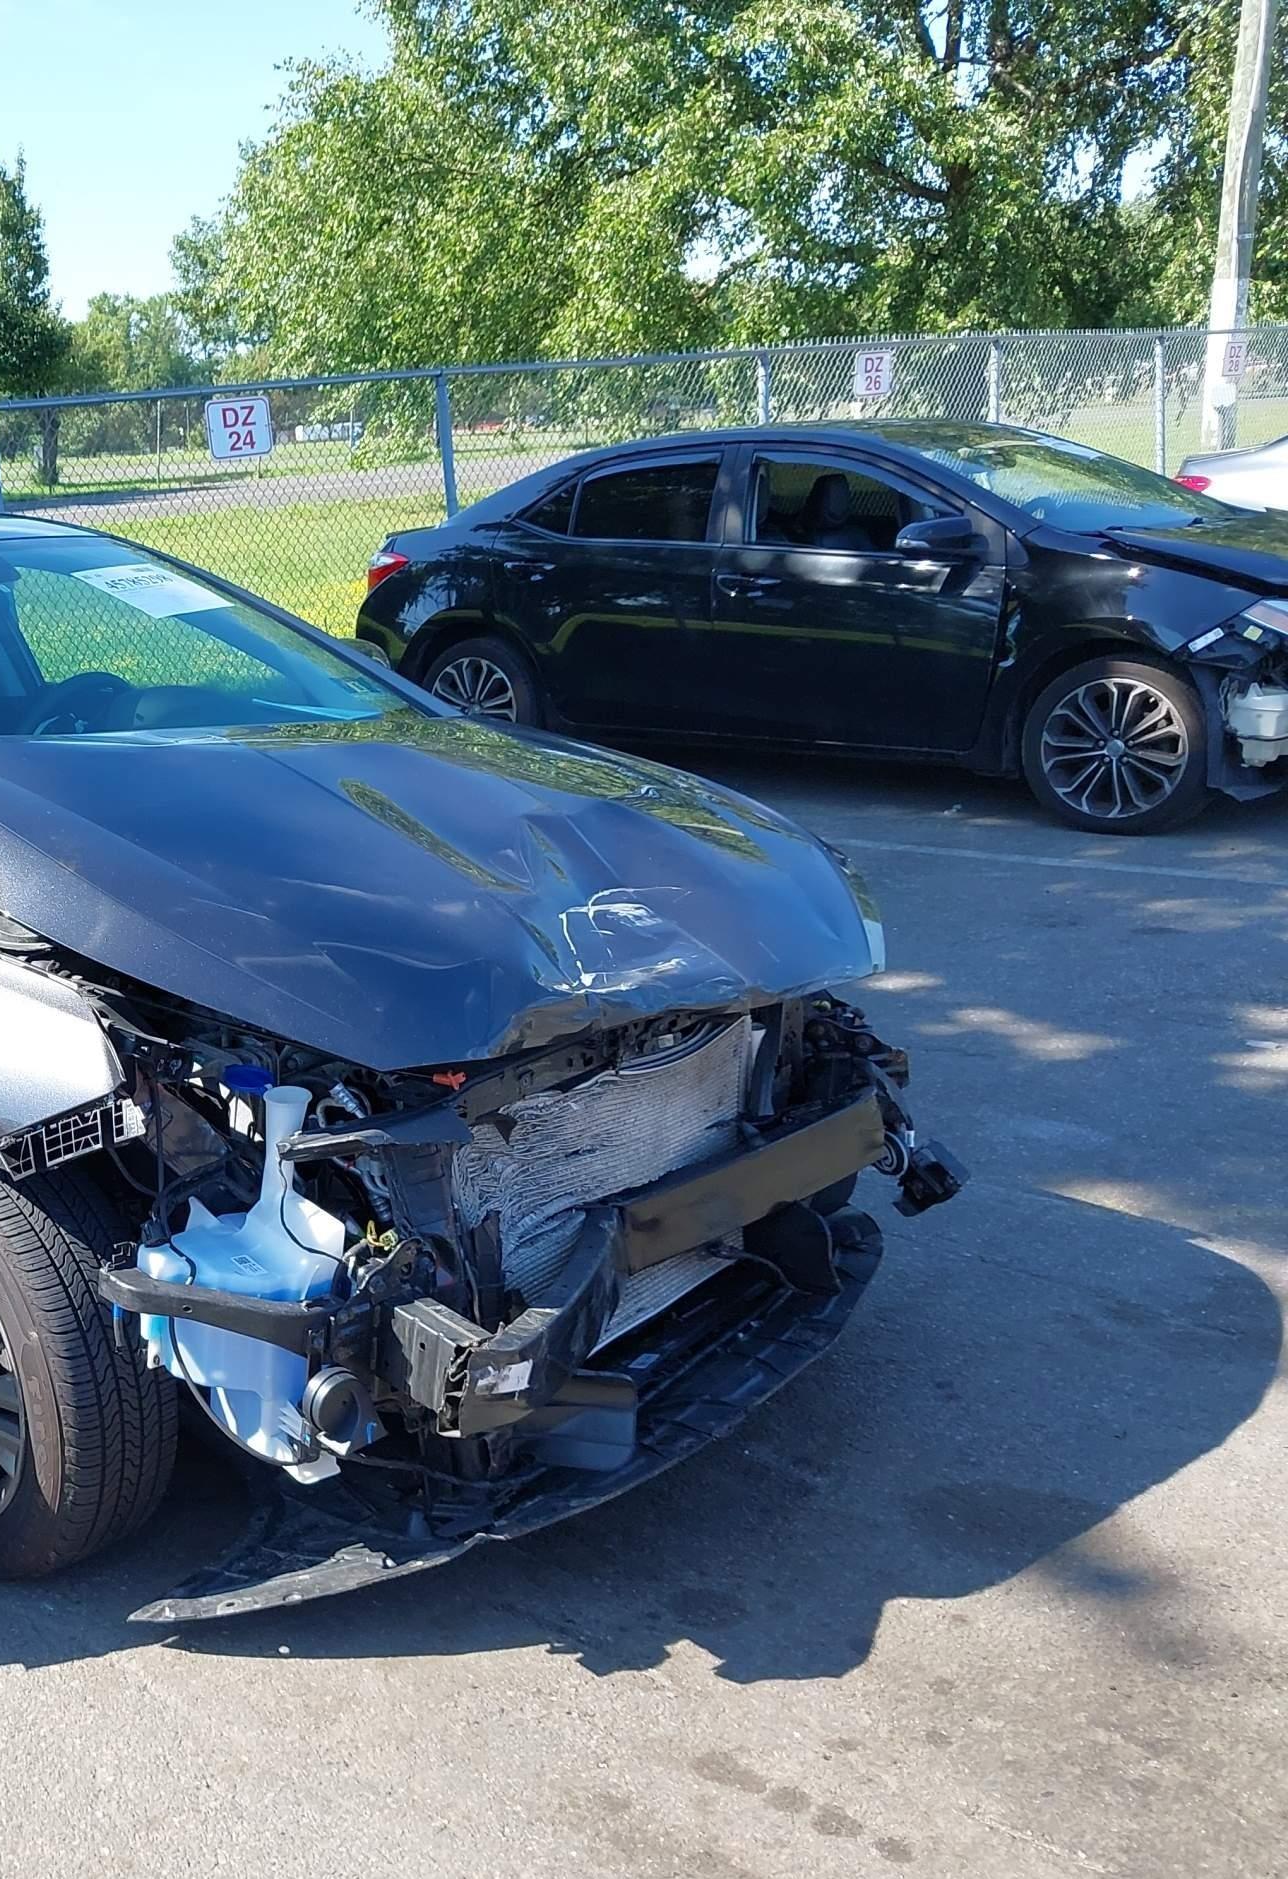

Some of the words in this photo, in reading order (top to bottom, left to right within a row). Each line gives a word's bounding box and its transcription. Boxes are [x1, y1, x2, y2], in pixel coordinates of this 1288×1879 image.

[1229, 346, 1242, 359] DZ
[864, 357, 884, 373] DZ
[865, 375, 881, 391] 26
[222, 405, 256, 428] DZ
[228, 430, 256, 451] 24
